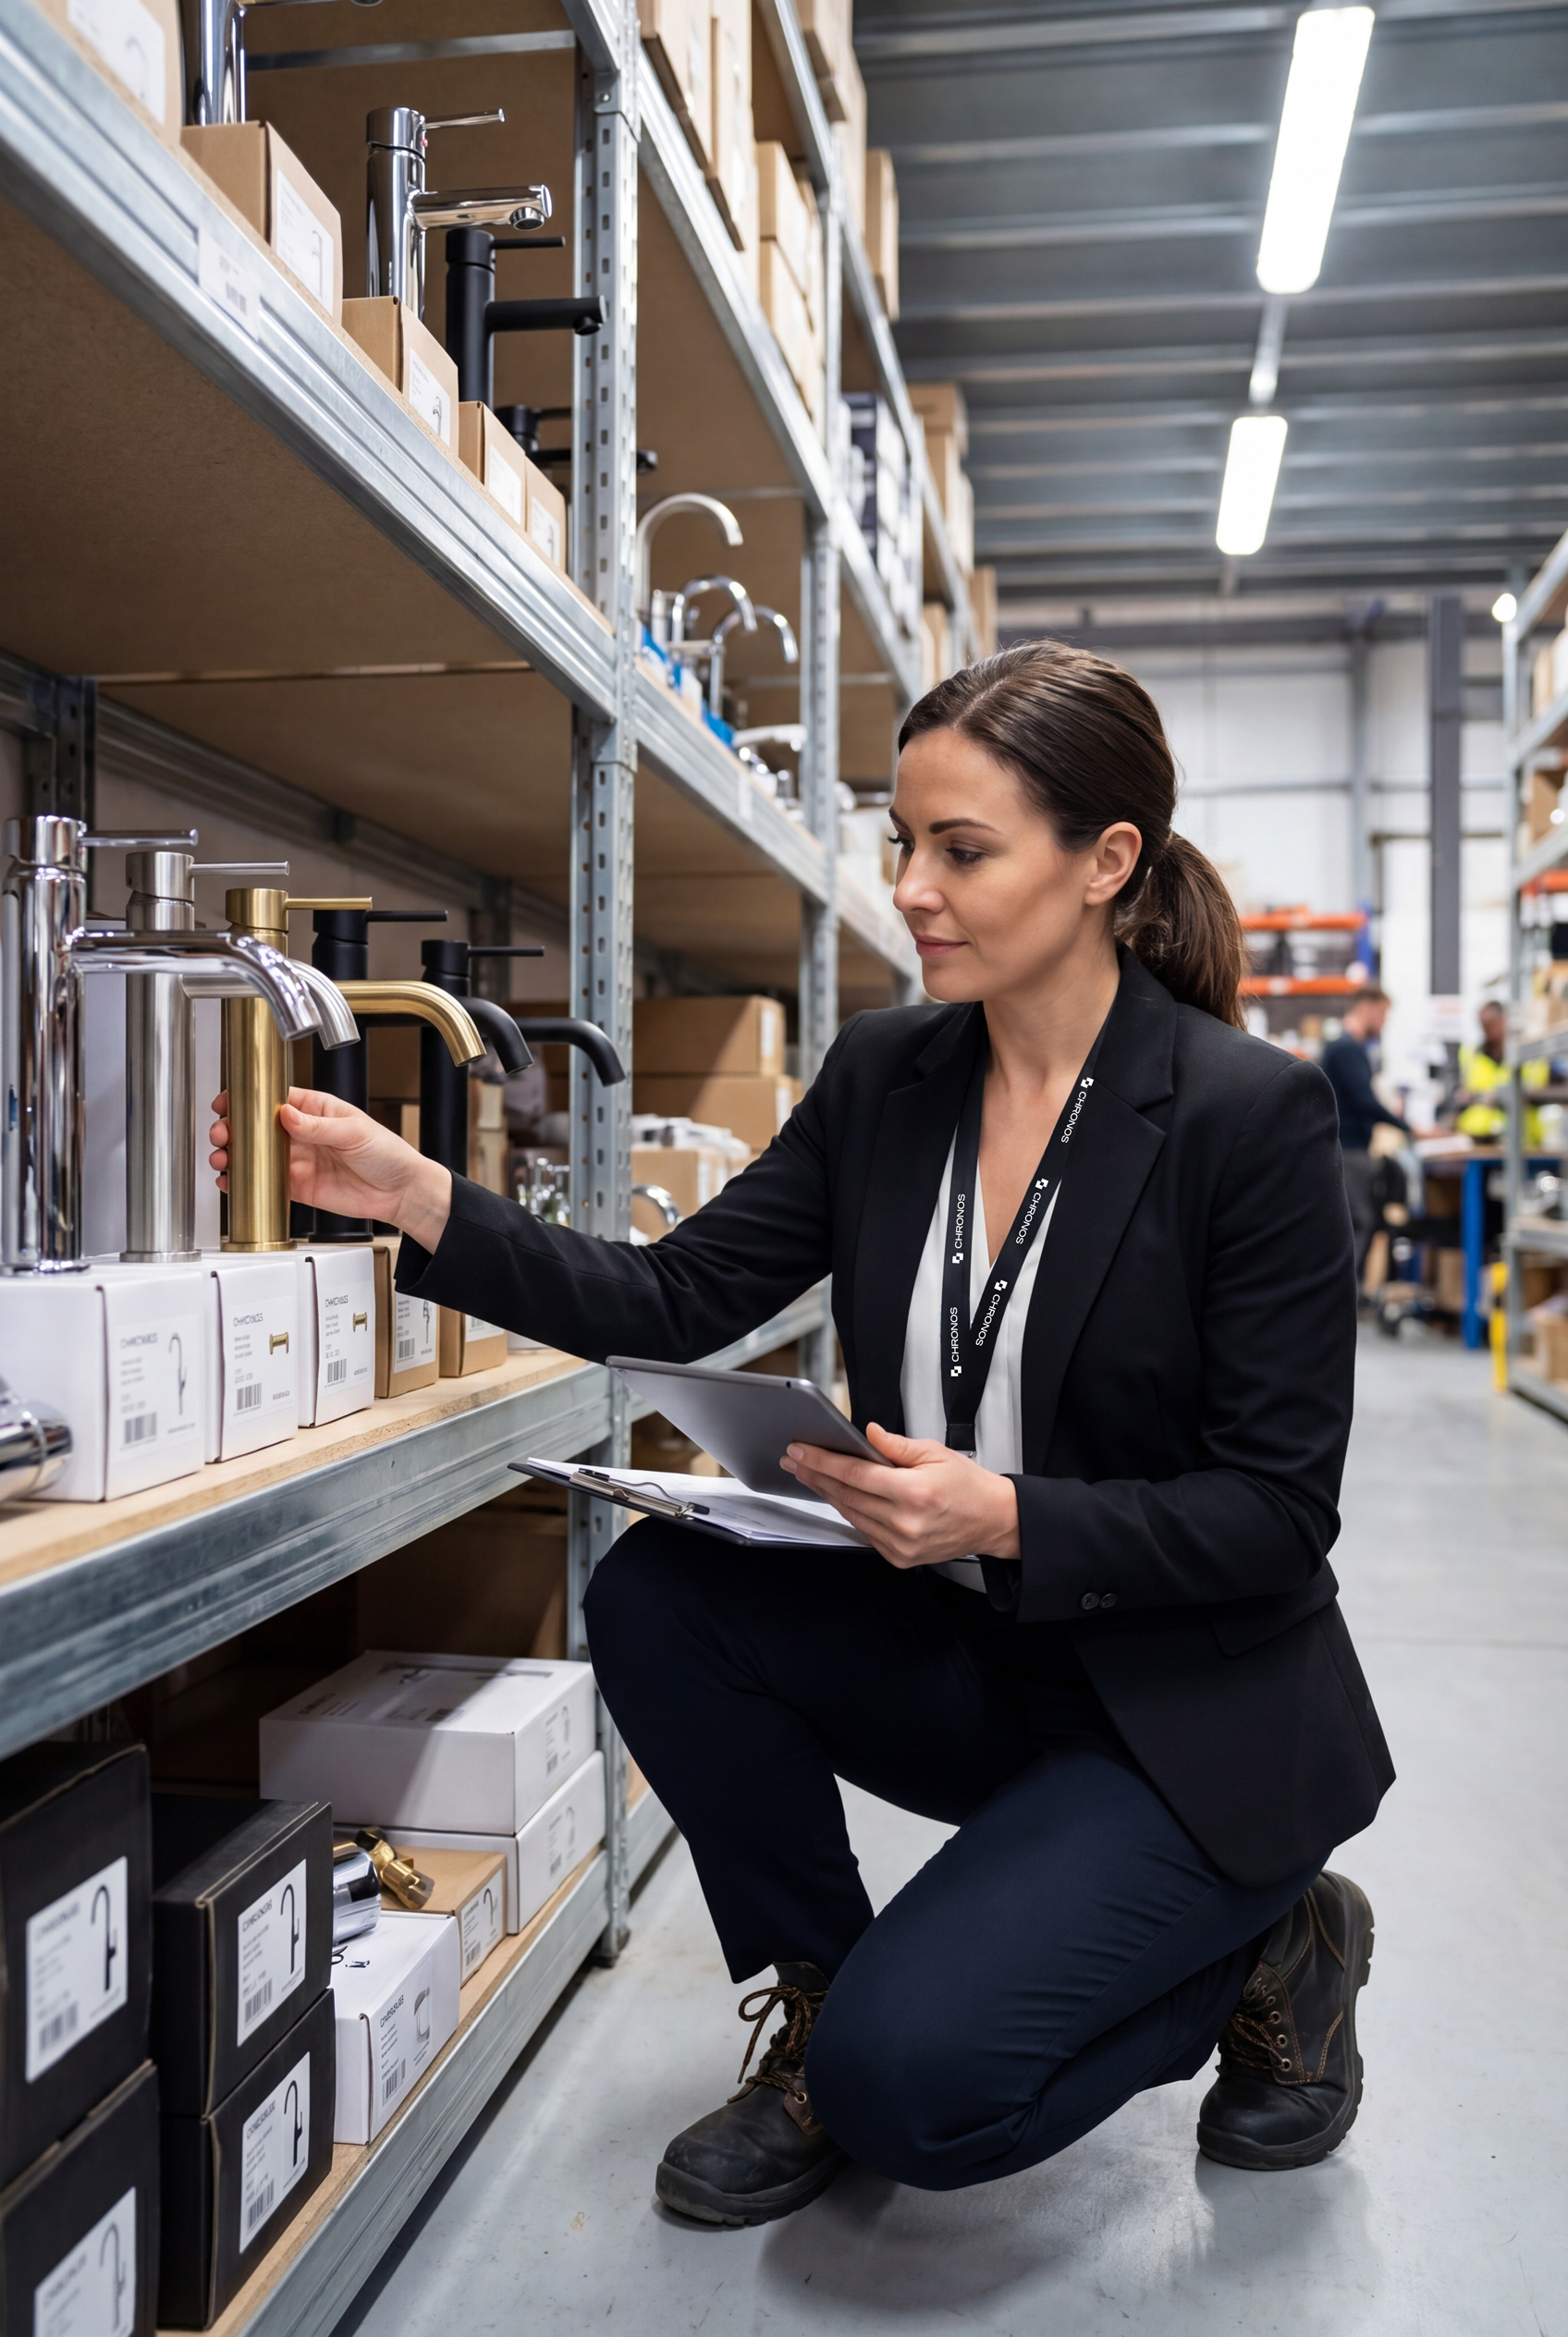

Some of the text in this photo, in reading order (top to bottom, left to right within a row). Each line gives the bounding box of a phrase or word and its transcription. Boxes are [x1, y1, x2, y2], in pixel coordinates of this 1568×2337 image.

[1060, 1091, 1087, 1144] CHRONOS
[954, 1193, 966, 1249] CHRONOS
[1015, 1192, 1042, 1244] CHRONOS
[949, 1306, 960, 1363] CHRONOS
[975, 1293, 1000, 1347] CHRONOS
